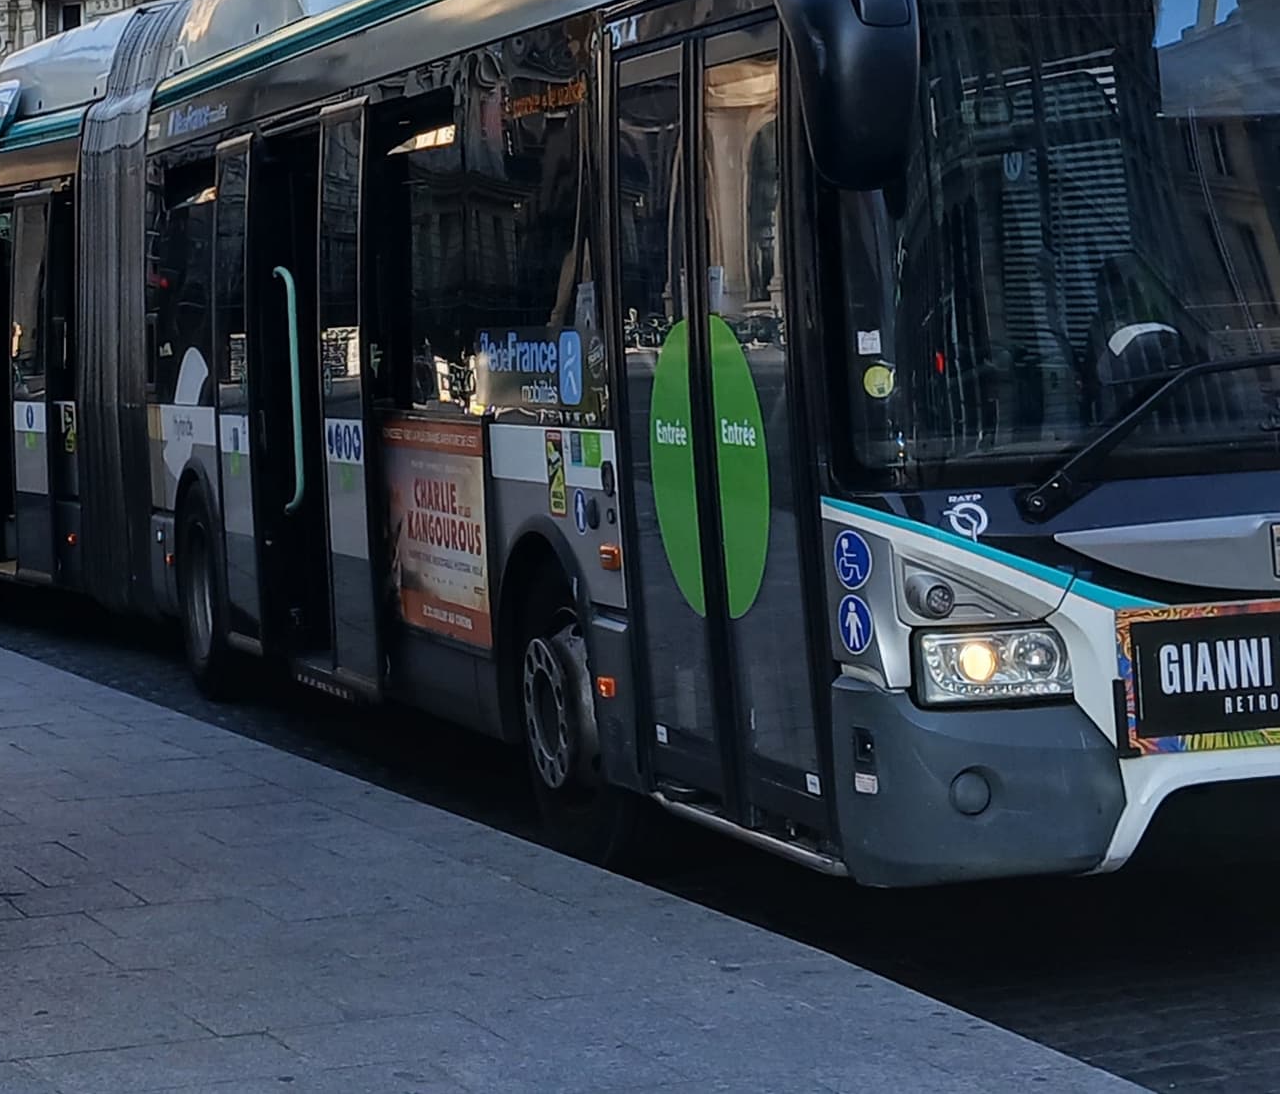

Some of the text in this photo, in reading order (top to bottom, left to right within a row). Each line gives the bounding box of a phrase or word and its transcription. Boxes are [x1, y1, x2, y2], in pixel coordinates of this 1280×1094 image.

[656, 418, 687, 446] Entrée
[721, 418, 756, 447] Entrée
[413, 477, 458, 515] CHARLIE
[948, 494, 982, 503] RATP
[406, 510, 482, 556] KANGOUROUS
[1159, 637, 1273, 695] GIANNI
